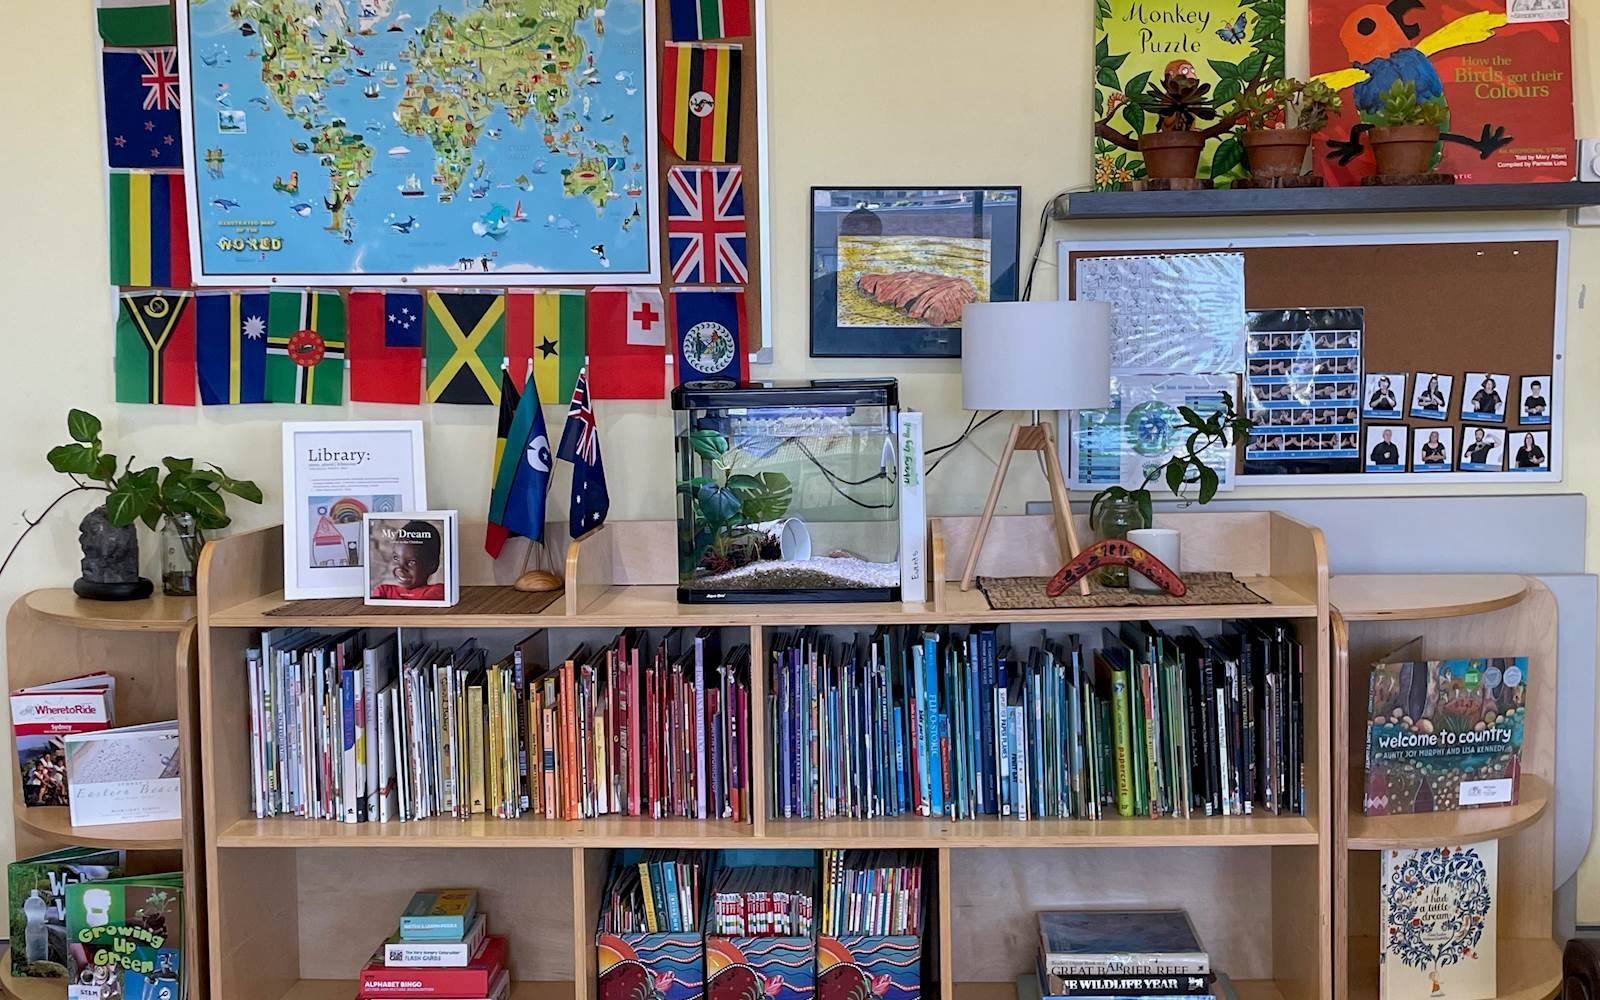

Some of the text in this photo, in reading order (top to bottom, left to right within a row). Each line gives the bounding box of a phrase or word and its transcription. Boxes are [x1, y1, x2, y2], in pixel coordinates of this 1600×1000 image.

[1122, 3, 1210, 33] Monkey
[1138, 28, 1201, 53] Puzzle
[1462, 55, 1512, 66] How the
[1455, 67, 1564, 85] Birds got their
[1475, 83, 1550, 99] Colours
[216, 236, 282, 251] WORLD
[308, 447, 371, 465] Library:
[381, 528, 432, 541] My Dream
[911, 550, 919, 580] Events
[35, 705, 97, 715] WheretoRide
[51, 723, 73, 731] Sydney
[1379, 726, 1512, 749] welcome to country
[1383, 745, 1505, 759] AUNTY JOY MURPHY AND LISA KENNEDY
[1117, 746, 1129, 796] papercraft
[1429, 893, 1447, 903] had
[1428, 904, 1448, 912] little
[1421, 912, 1450, 921] dream
[79, 926, 165, 949] Growing
[113, 938, 136, 953] Up
[94, 949, 153, 974] Green
[1051, 966, 1095, 975] GREAT
[1156, 966, 1189, 974] REEF
[1080, 979, 1143, 990] WILDLIFE
[1143, 979, 1178, 989] YEAR
